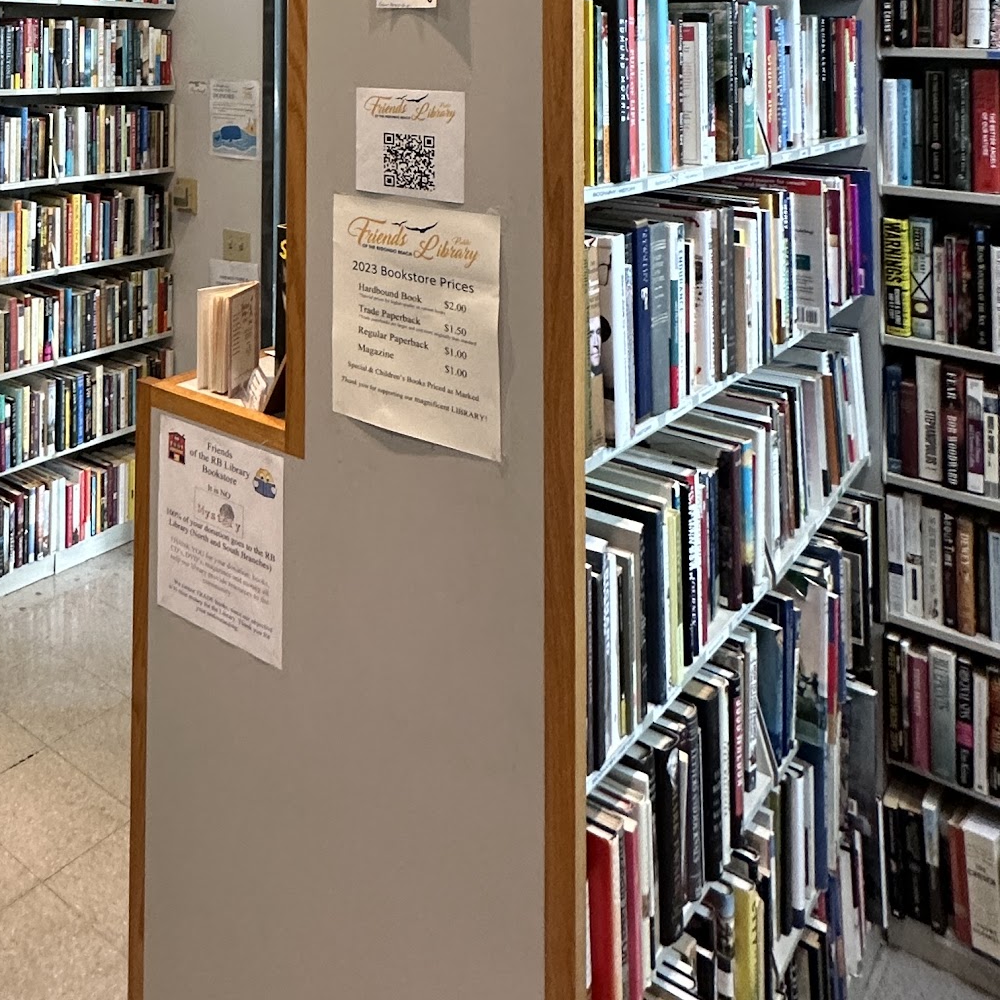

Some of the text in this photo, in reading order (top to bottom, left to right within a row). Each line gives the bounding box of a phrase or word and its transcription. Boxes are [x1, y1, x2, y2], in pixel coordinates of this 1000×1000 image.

[364, 95, 456, 124] Friends Library
[347, 216, 479, 268] Friends Library
[884, 222, 903, 283] WARNINGS
[352, 260, 475, 293] 2023 Bookstore Prices
[358, 283, 422, 303] Hardbound Book
[444, 300, 467, 313] $2.00
[358, 304, 380, 316] Trade
[381, 309, 421, 325] Paperback
[358, 325, 387, 340] Regular
[389, 332, 429, 350] Paperback
[444, 323, 467, 336] $1.50
[358, 343, 394, 359] Magazine
[444, 346, 467, 360] $1.00
[347, 361, 367, 372] Special
[374, 368, 405, 382] Children's
[406, 375, 426, 387] Books
[427, 381, 446, 393] Priced
[455, 389, 480, 401] Marked
[444, 364, 467, 378] $1.00
[341, 375, 357, 386] Thank
[414, 396, 450, 411] magnificent
[451, 406, 488, 421] LIBRARY!
[946, 372, 958, 485] FEAR BOB WOODWARD
[189, 449, 250, 479] of the RB Library
[207, 442, 233, 459] Friends
[202, 464, 237, 486] Bookstore
[207, 484, 213, 492] It
[220, 490, 231, 500] NO
[168, 518, 188, 534] Library
[210, 539, 221, 548] and
[222, 542, 240, 556] South
[241, 550, 273, 573] Branches)
[189, 519, 203, 530] your
[204, 525, 230, 541] donation
[231, 538, 245, 549] goes
[246, 544, 252, 552] to
[253, 546, 263, 557] the
[960, 533, 970, 566] DEWEY
